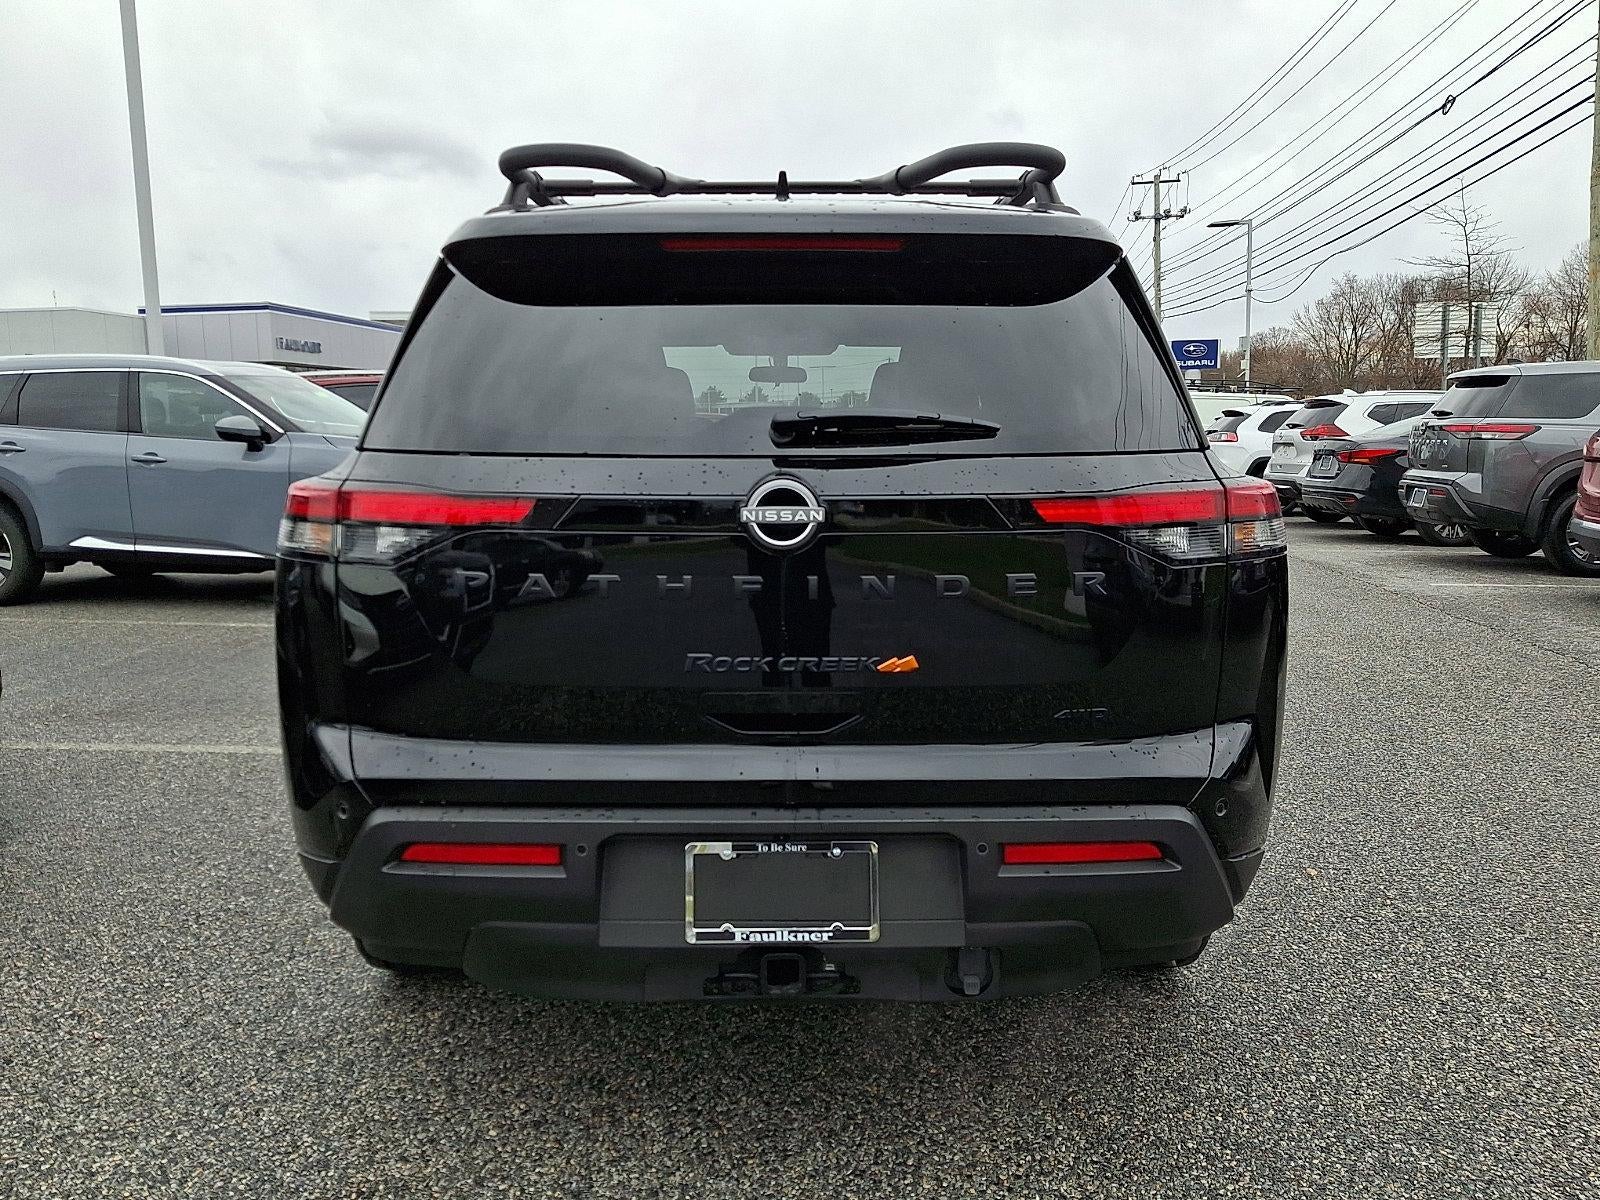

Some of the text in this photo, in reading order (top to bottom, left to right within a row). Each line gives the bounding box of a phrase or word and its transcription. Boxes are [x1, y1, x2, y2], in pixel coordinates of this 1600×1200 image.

[742, 510, 823, 521] NISSAN
[448, 570, 1108, 598] PATHFINDER
[684, 653, 881, 672] ROCK CREEK
[756, 842, 808, 852] To Be Sure
[734, 930, 834, 942] Faulkner
